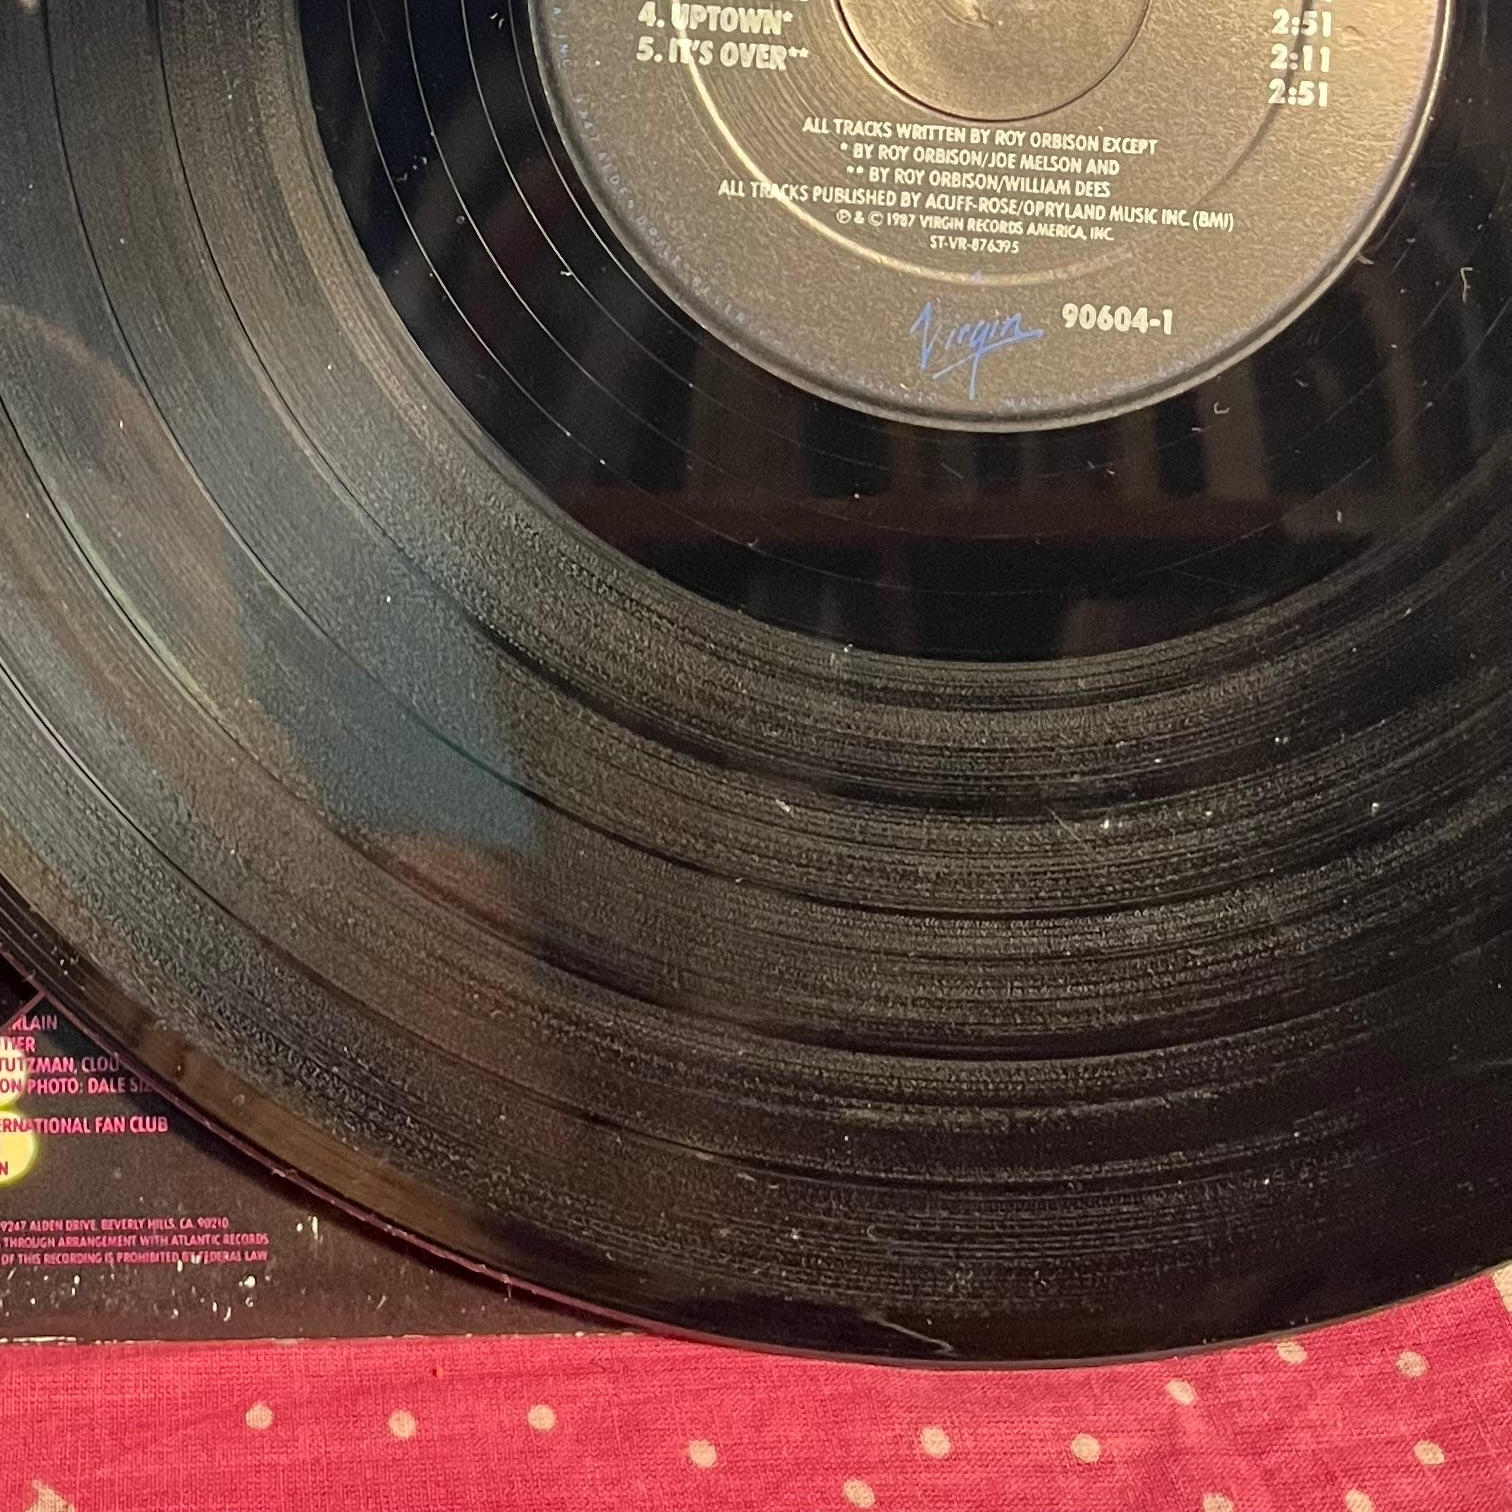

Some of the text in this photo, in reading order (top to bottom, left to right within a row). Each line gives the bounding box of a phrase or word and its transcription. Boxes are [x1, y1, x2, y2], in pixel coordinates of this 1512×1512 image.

[638, 1, 666, 28] 4.
[1271, 8, 1333, 38] 2:51
[636, 36, 664, 63] 5.
[668, 37, 714, 66] IT'S
[1270, 43, 1331, 72] 2:11
[1267, 78, 1329, 108] 2:51
[833, 118, 1159, 155] TRACKS WRITTEN ORBISON EXCEPT
[1019, 154, 1082, 173] MELSON
[812, 186, 1158, 224] PUBLISHED MUSIC
[1062, 302, 1173, 335] 90604-1
[909, 301, 1044, 401] Virgin
[27, 1078, 83, 1094] PHOTO:
[87, 1078, 125, 1094] DALE
[95, 1117, 125, 1133] FAN
[129, 1115, 168, 1132] CLUB
[101, 1218, 145, 1231] BEVERLY
[4, 1236, 56, 1249] THROUGH
[139, 1234, 169, 1247] WITH
[171, 1234, 220, 1246] ATLANTIC
[18, 1253, 41, 1264] THIS
[43, 1251, 102, 1265] RECORDING
